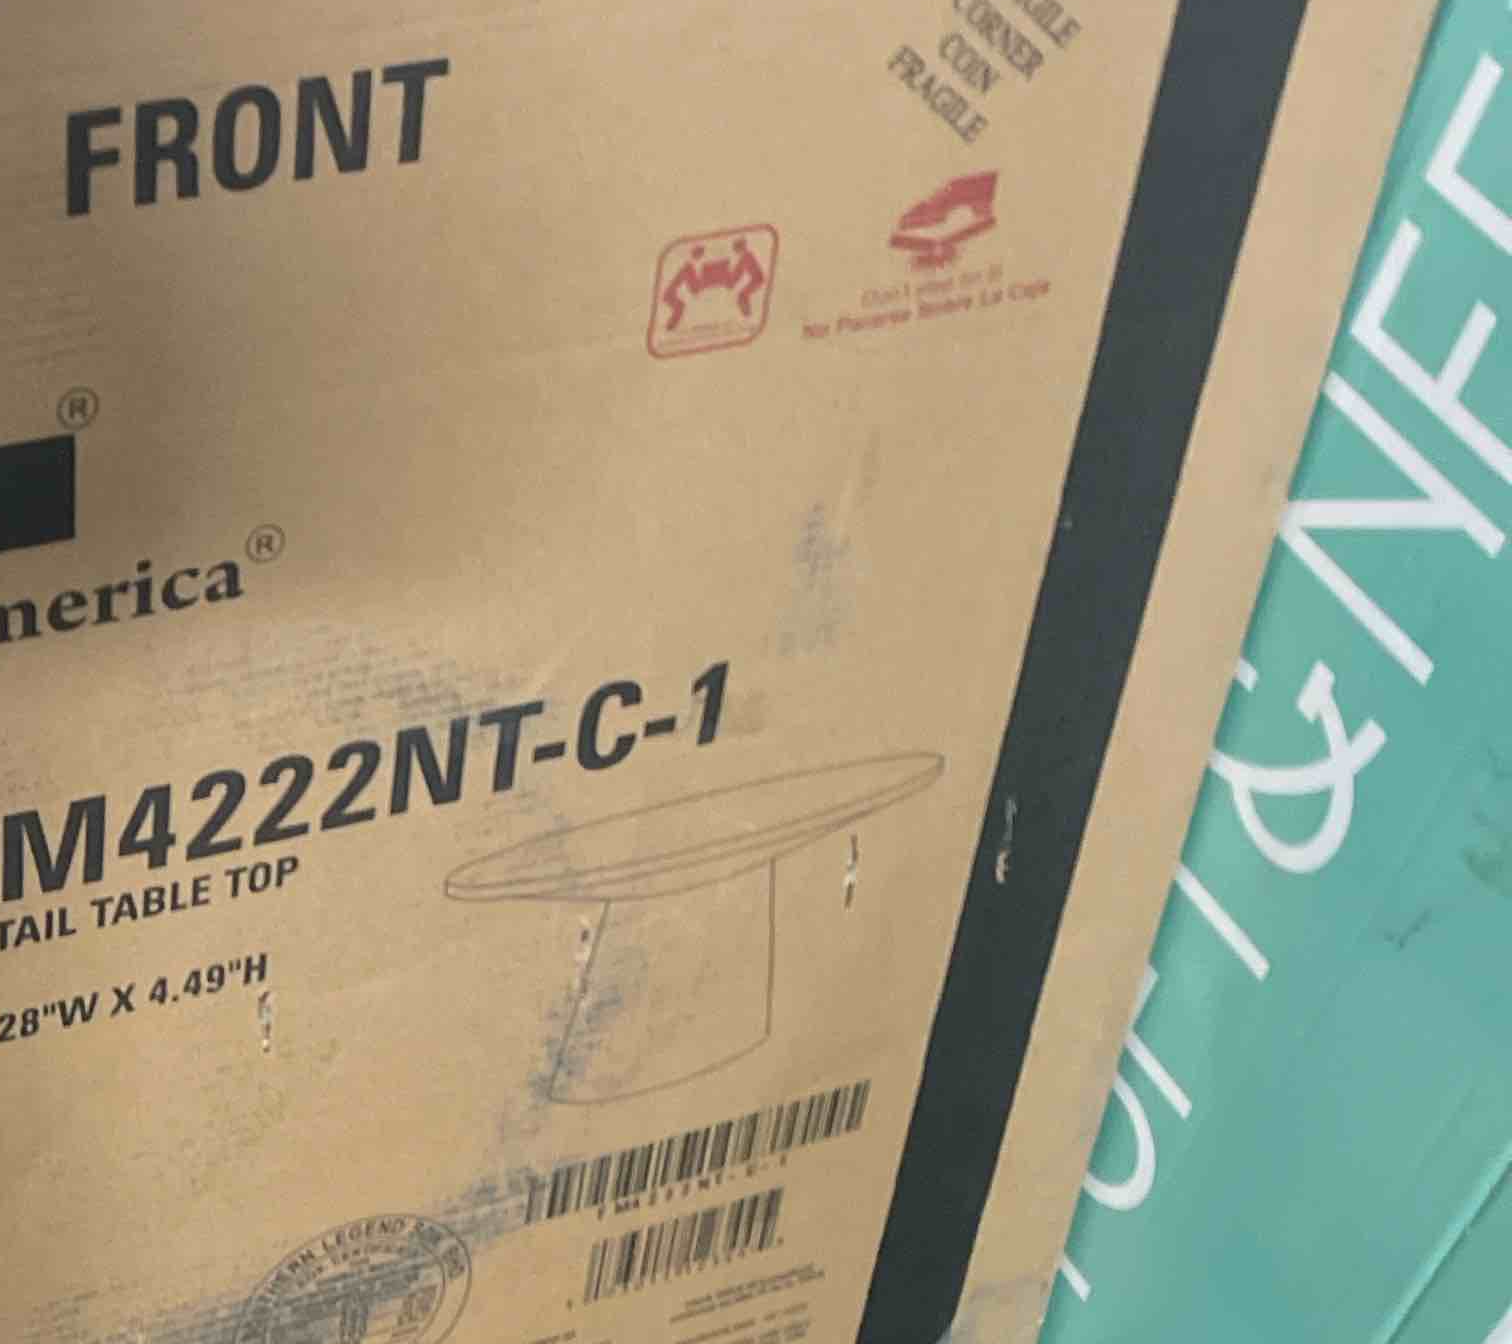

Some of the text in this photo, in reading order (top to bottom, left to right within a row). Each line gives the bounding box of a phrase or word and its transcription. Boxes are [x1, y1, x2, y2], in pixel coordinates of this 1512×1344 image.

[888, 44, 988, 143] FRAGILE
[938, 31, 1000, 96] COIN
[67, 57, 450, 217] FRONT
[90, 873, 212, 929] TABLE
[225, 855, 300, 898] TOP
[109, 983, 136, 1017] X
[148, 953, 268, 1005] 4.49"H
